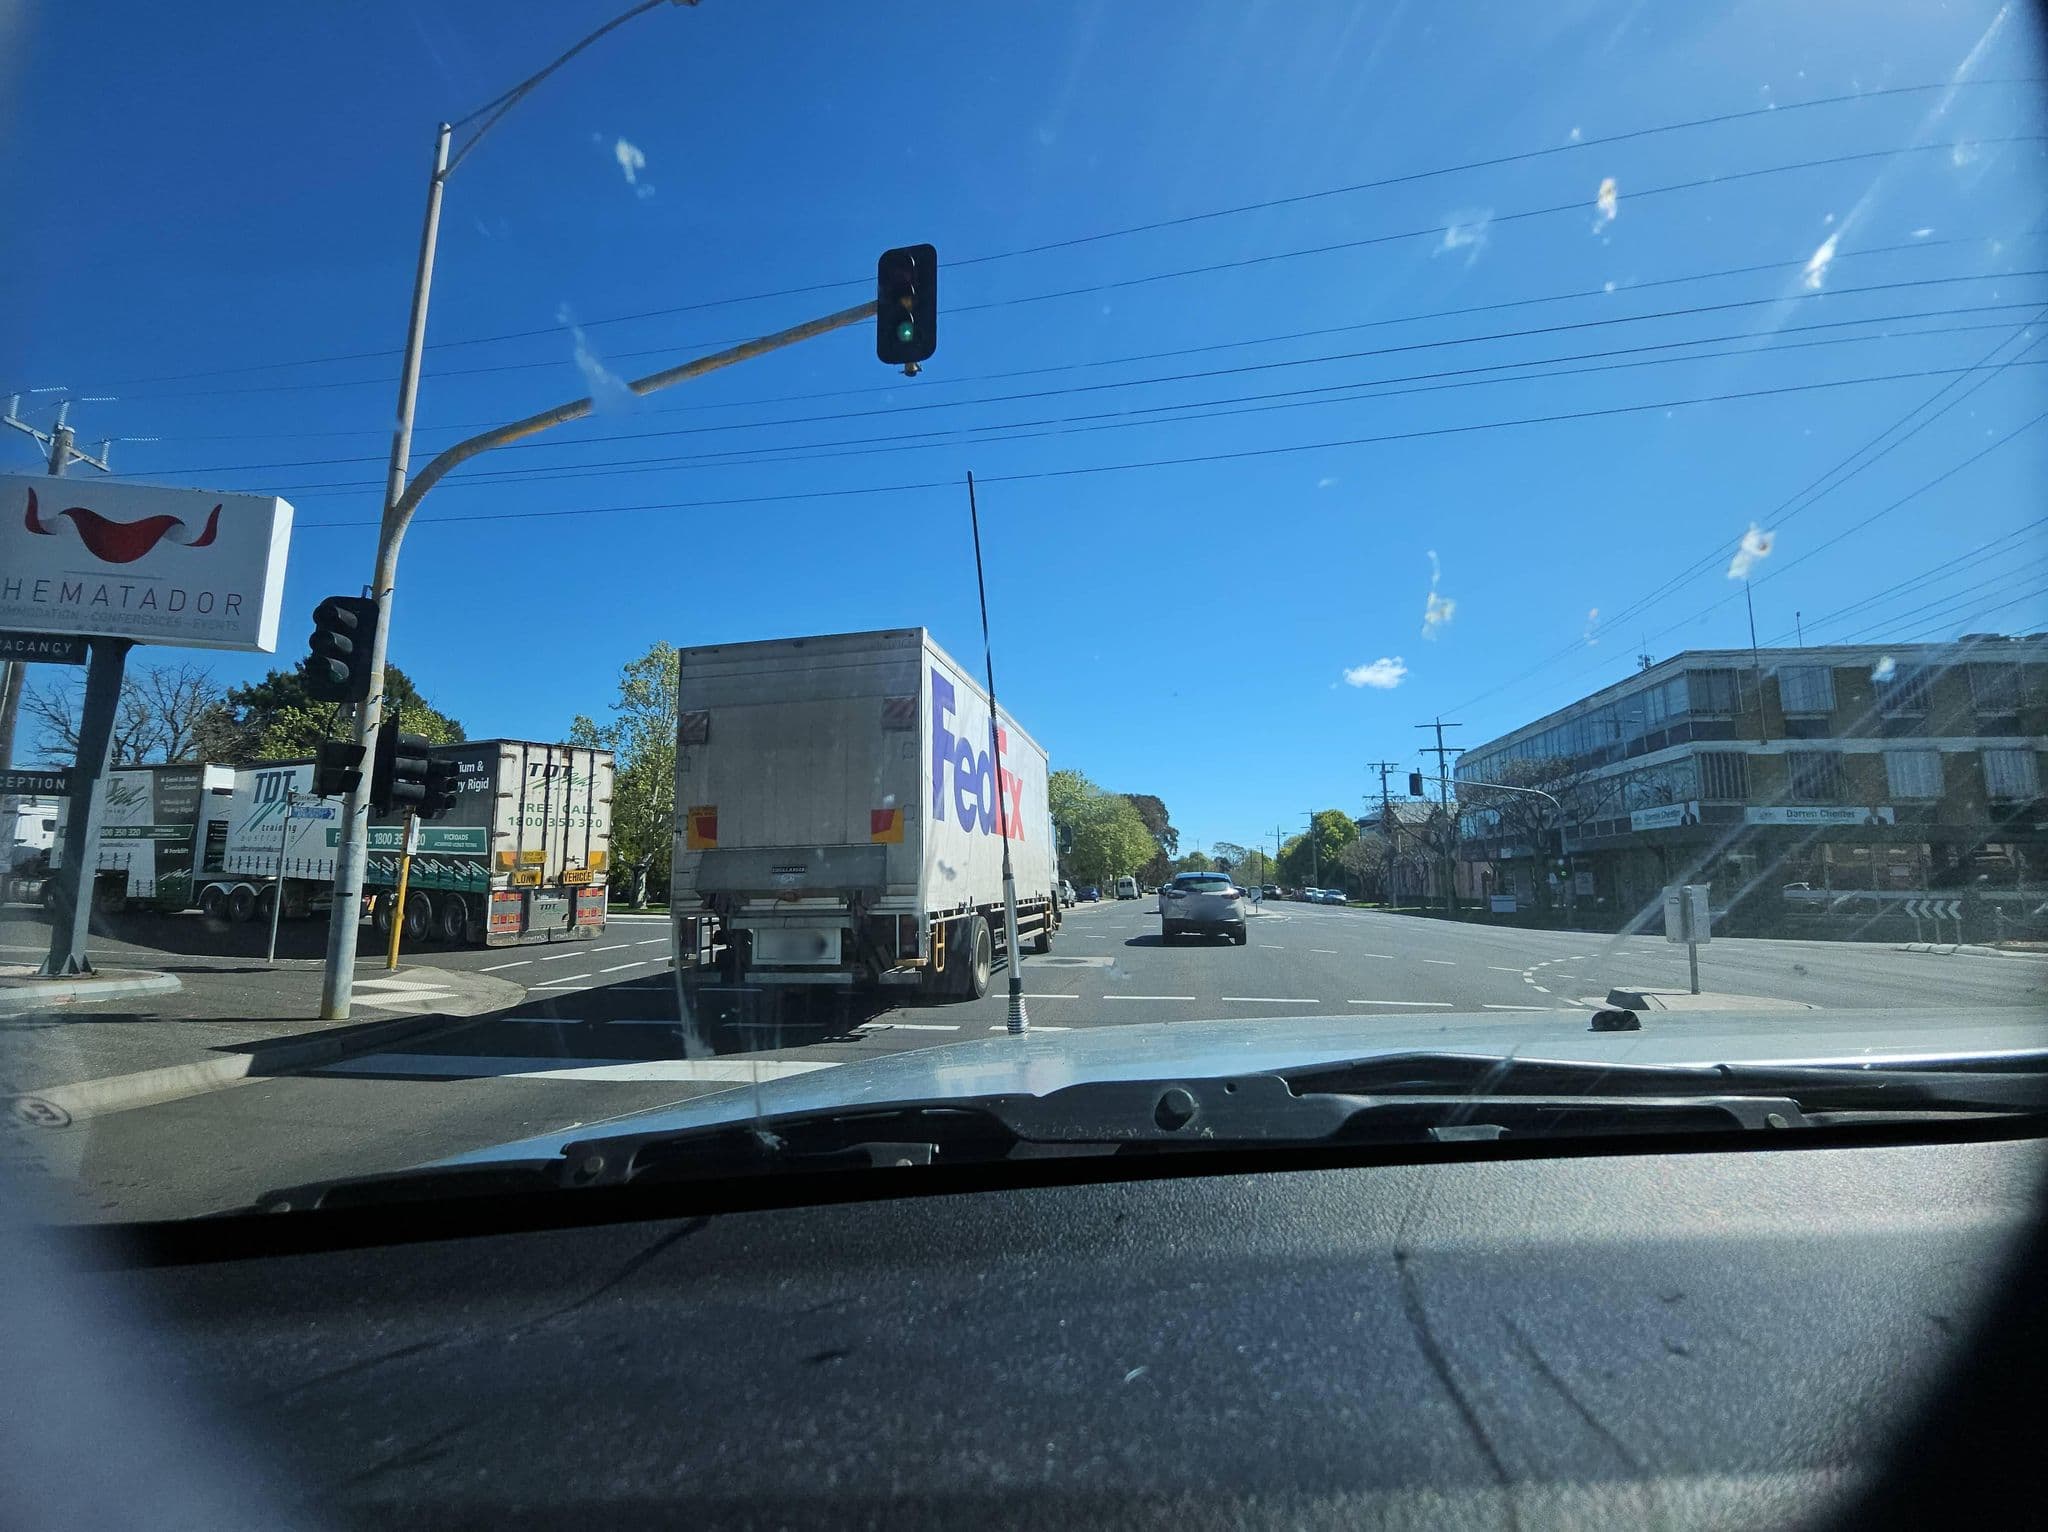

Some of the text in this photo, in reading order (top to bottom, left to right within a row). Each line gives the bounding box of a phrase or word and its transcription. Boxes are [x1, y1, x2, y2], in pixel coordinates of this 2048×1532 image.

[931, 666, 1025, 842] FedEx
[528, 762, 574, 778] TDT
[253, 770, 297, 804] TDT
[467, 777, 489, 792] Rigid
[518, 803, 598, 816] FREE CALL
[508, 816, 543, 828] 1800
[548, 818, 575, 829] 350
[376, 834, 392, 845] 1800
[564, 869, 593, 883] VEHICLE
